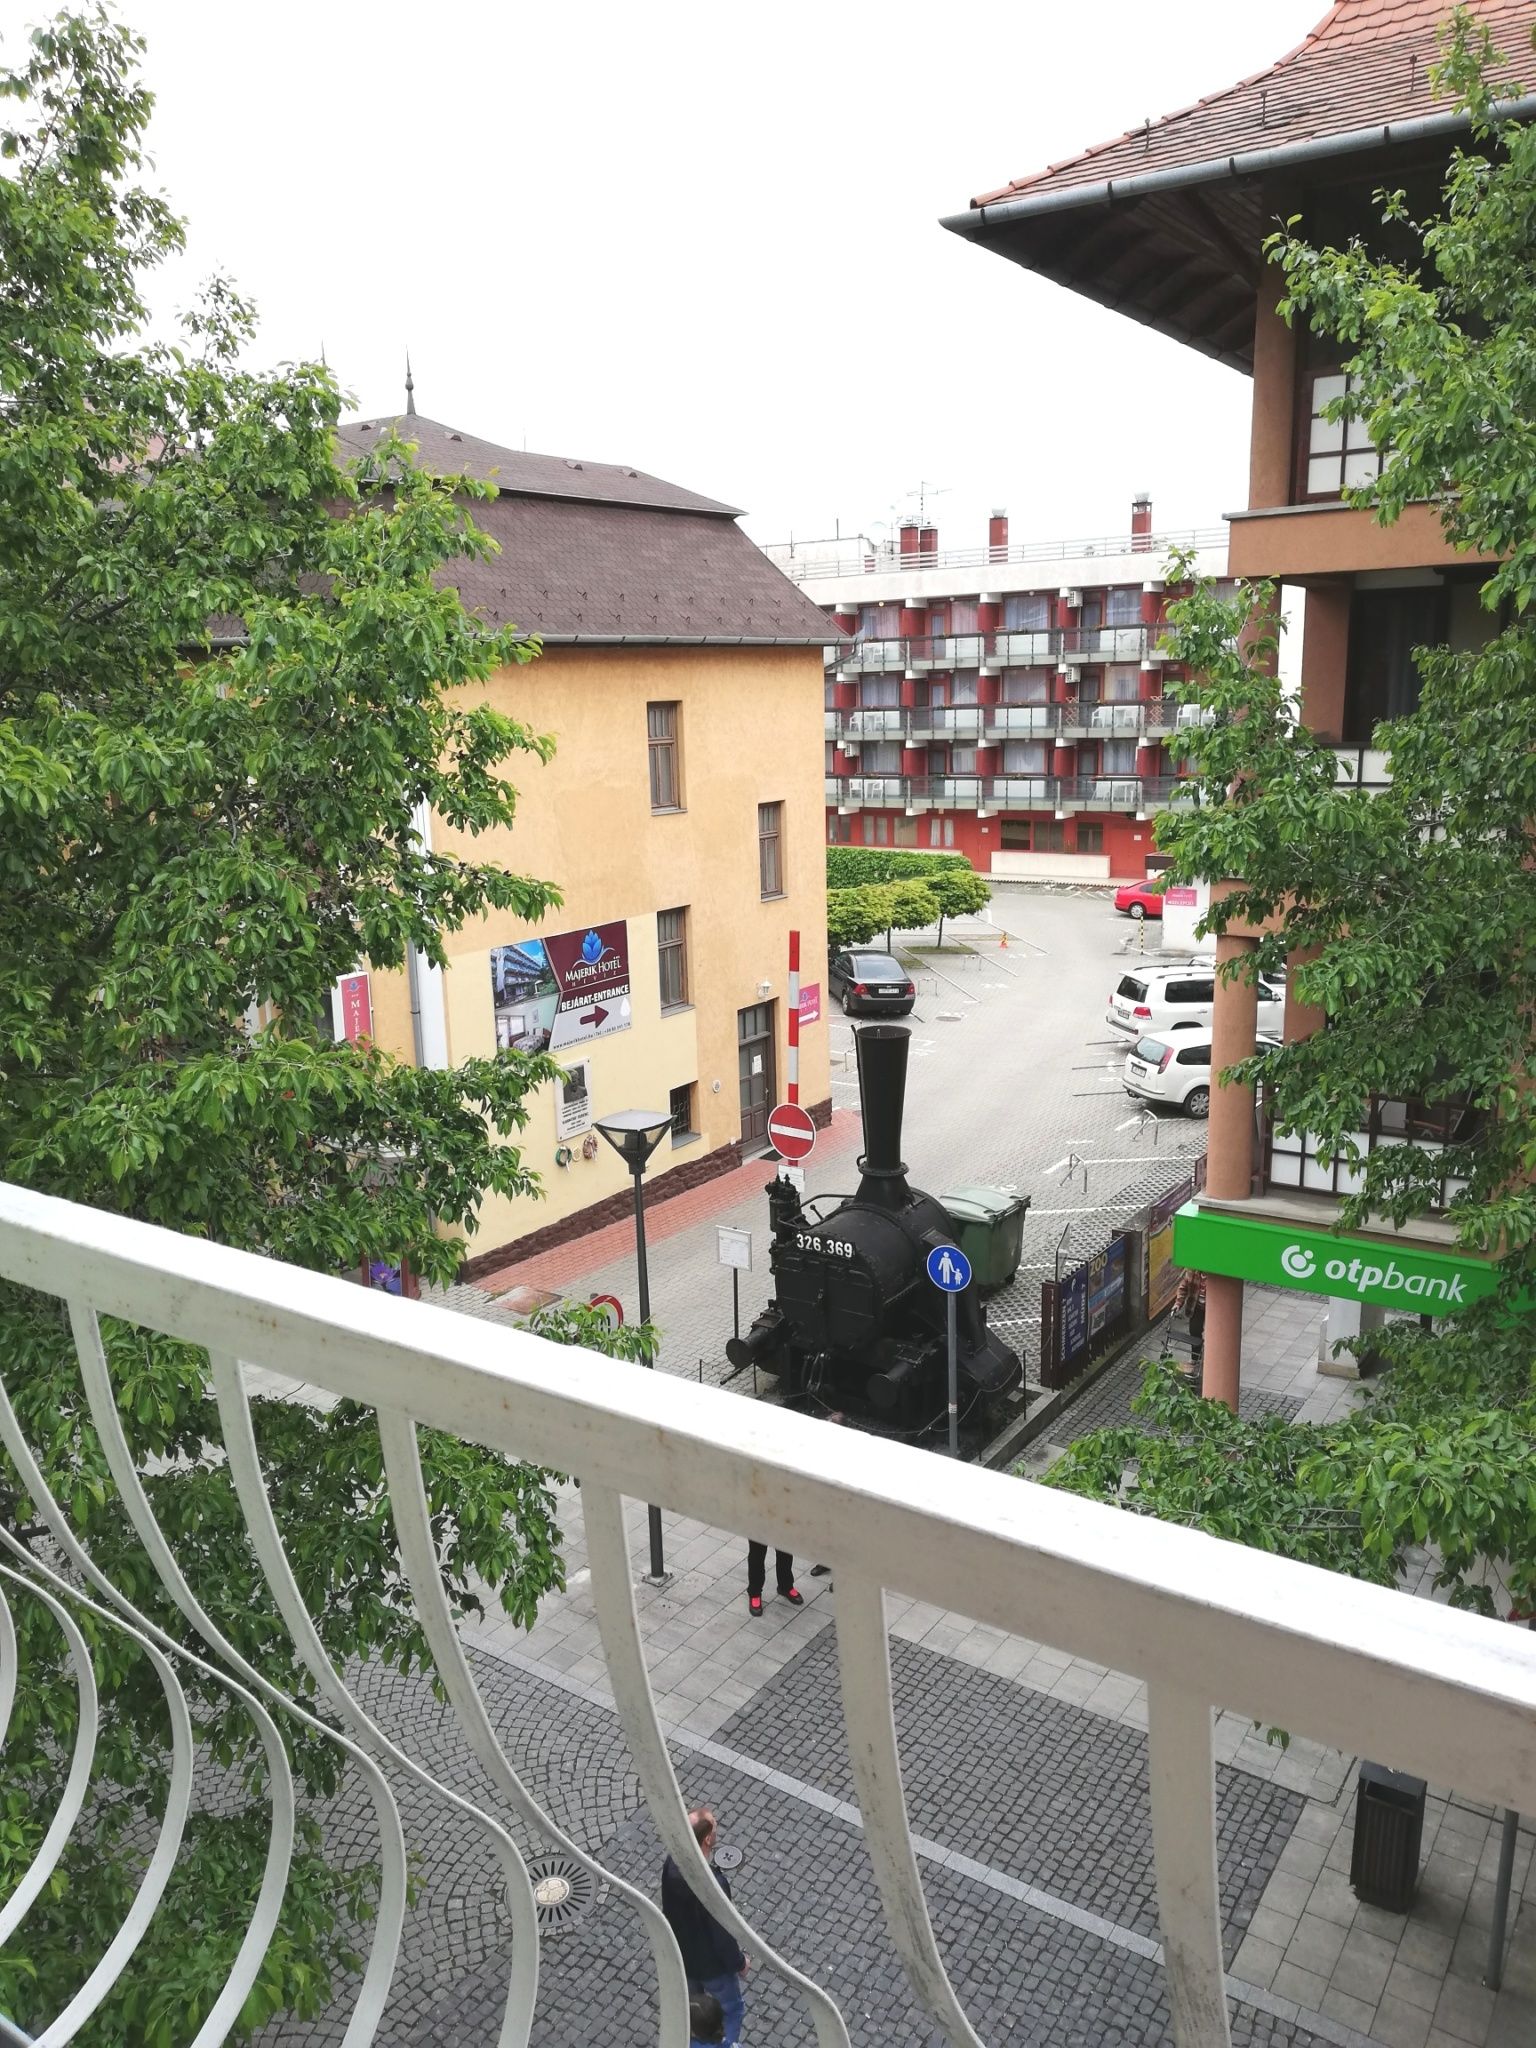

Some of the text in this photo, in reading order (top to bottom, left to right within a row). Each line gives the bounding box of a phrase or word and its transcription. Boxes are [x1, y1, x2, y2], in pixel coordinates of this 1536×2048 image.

[565, 958, 622, 982] MAJERIK HOTEL
[561, 984, 629, 1011] BEJÁRAT-ENTRANCE
[796, 1233, 853, 1258] 326.369
